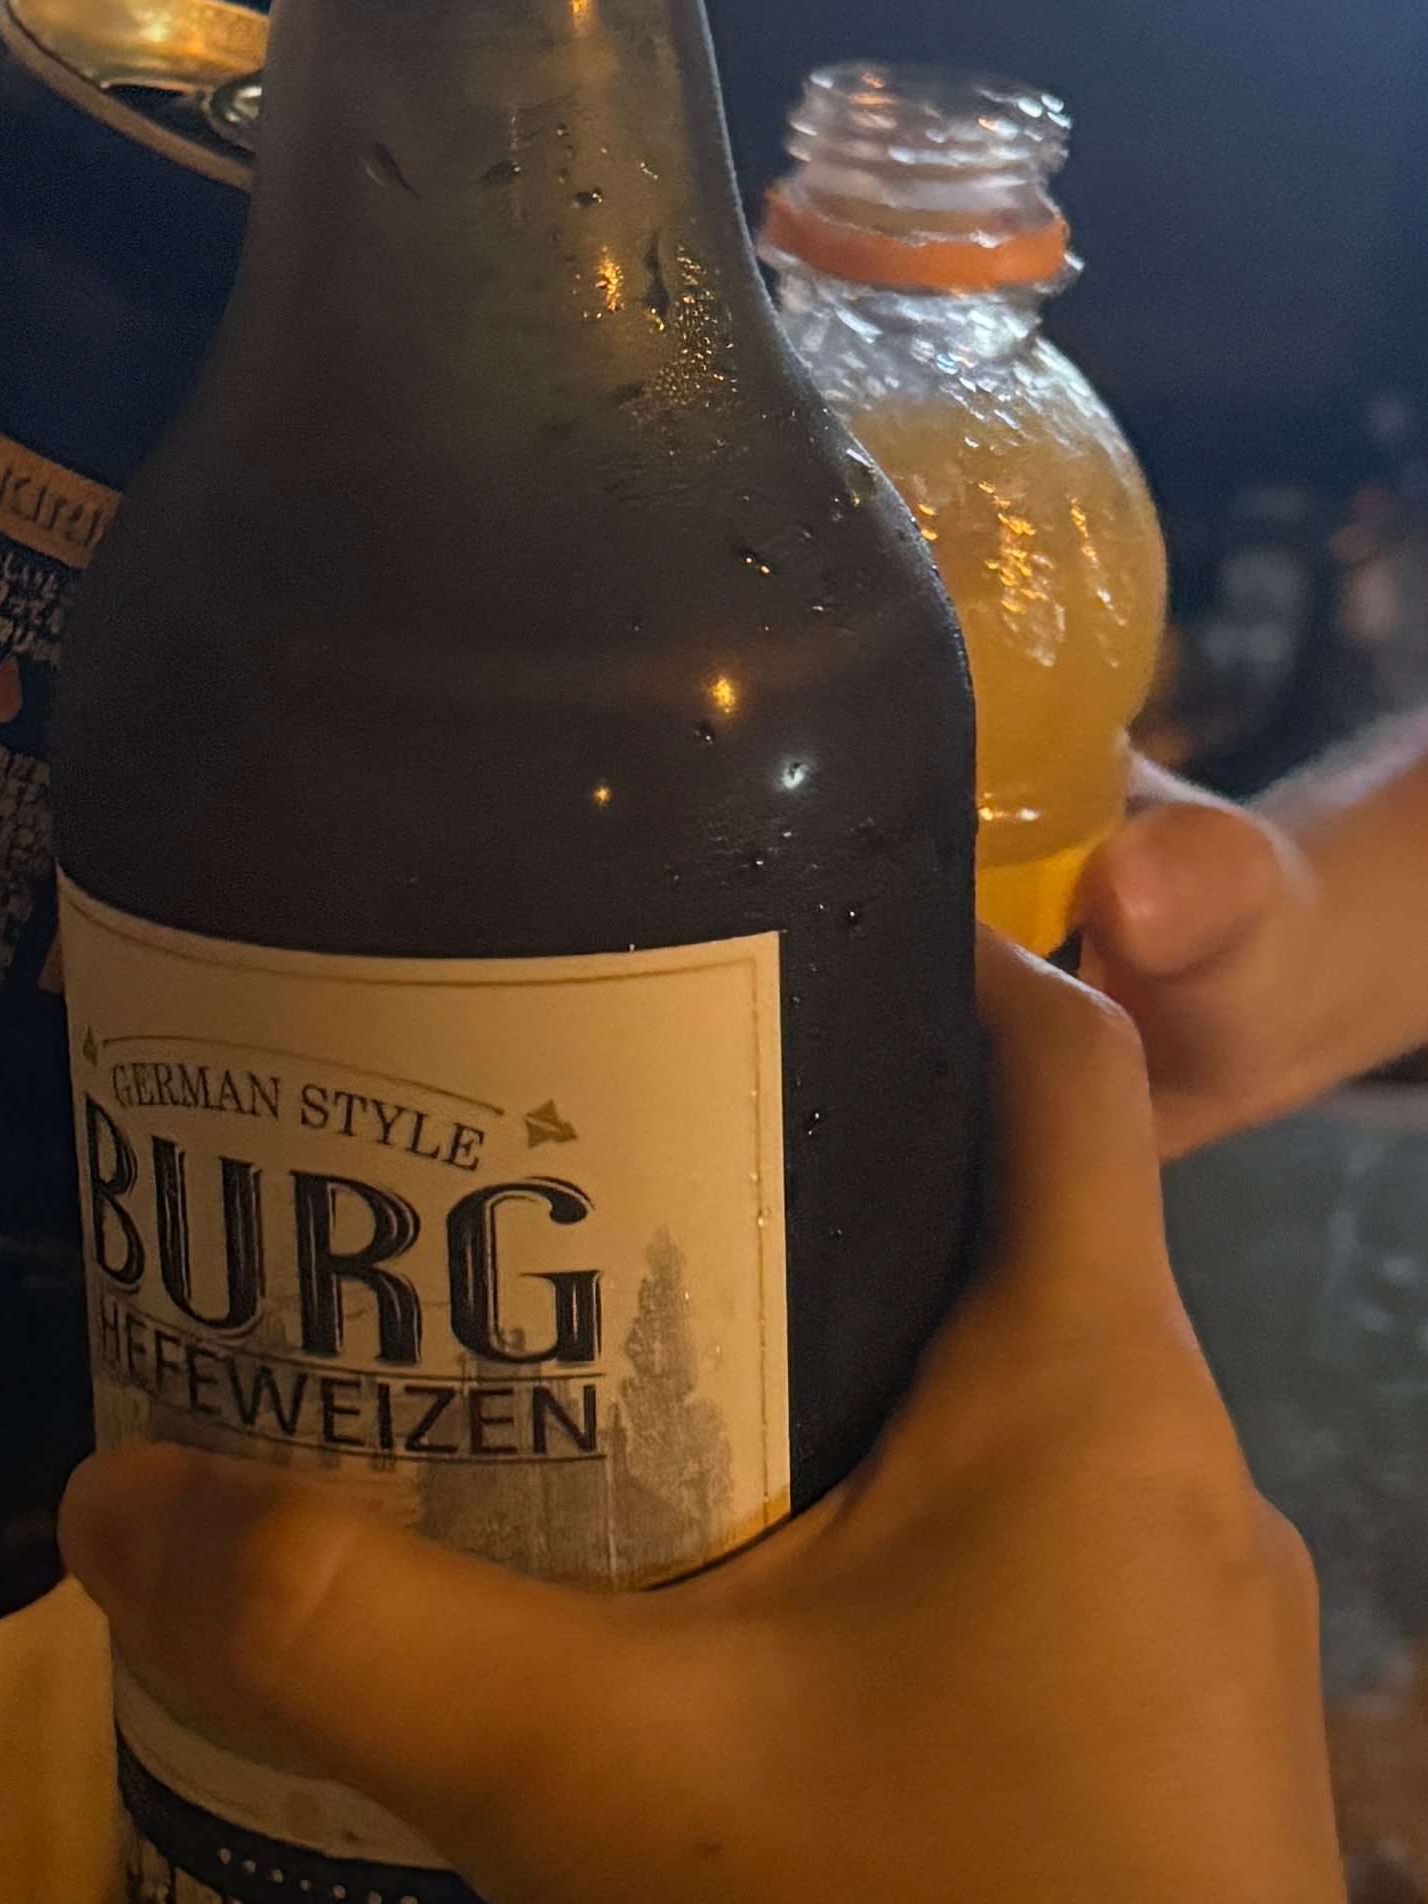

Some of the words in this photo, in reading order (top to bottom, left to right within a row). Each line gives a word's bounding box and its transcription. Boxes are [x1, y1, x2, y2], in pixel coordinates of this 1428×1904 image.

[112, 1062, 282, 1120] GERMAN
[300, 1083, 487, 1172] STYLE
[85, 1094, 605, 1367] BURG
[100, 1296, 598, 1456] HEFEWEIZEN
